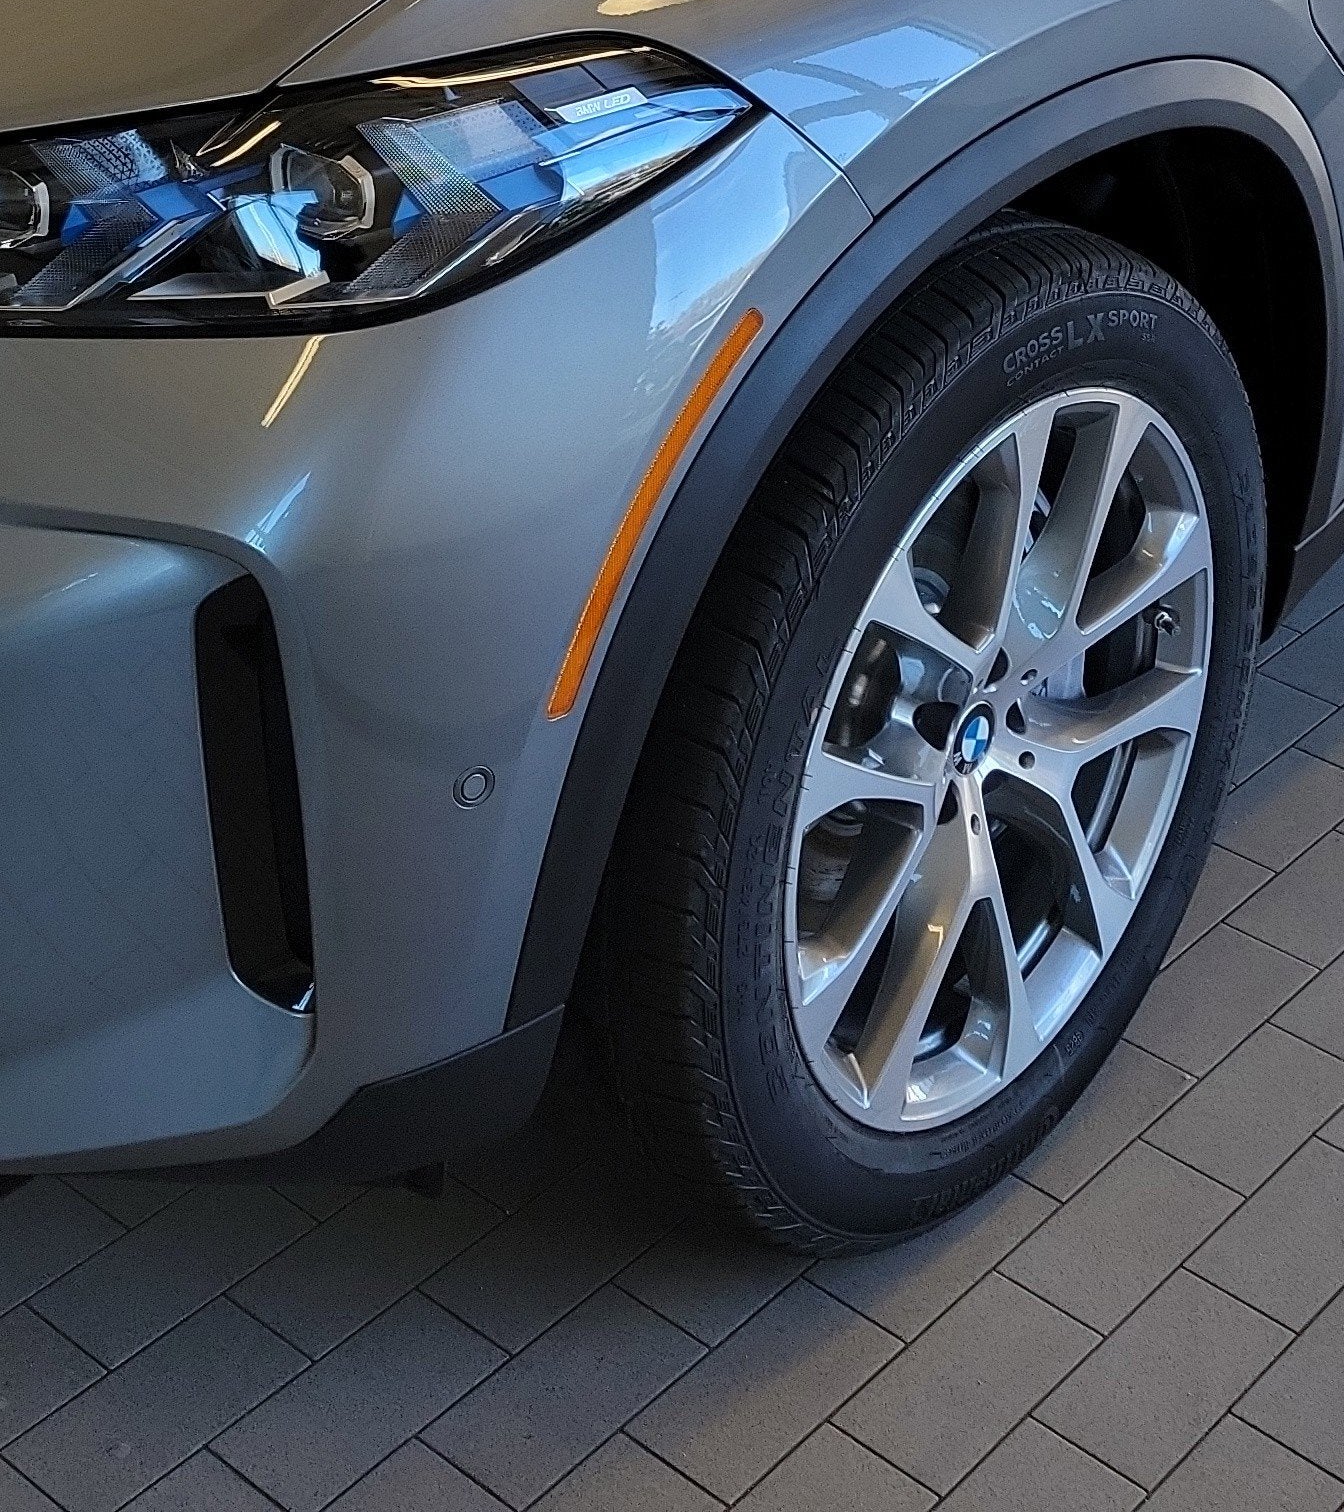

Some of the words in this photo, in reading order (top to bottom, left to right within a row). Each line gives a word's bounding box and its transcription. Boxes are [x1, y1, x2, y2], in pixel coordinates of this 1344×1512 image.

[603, 93, 632, 109] LED
[1003, 326, 1063, 373] CROSS
[1066, 312, 1106, 350] LX
[1107, 309, 1158, 330] SPORT
[1006, 345, 1064, 387] CONTACT
